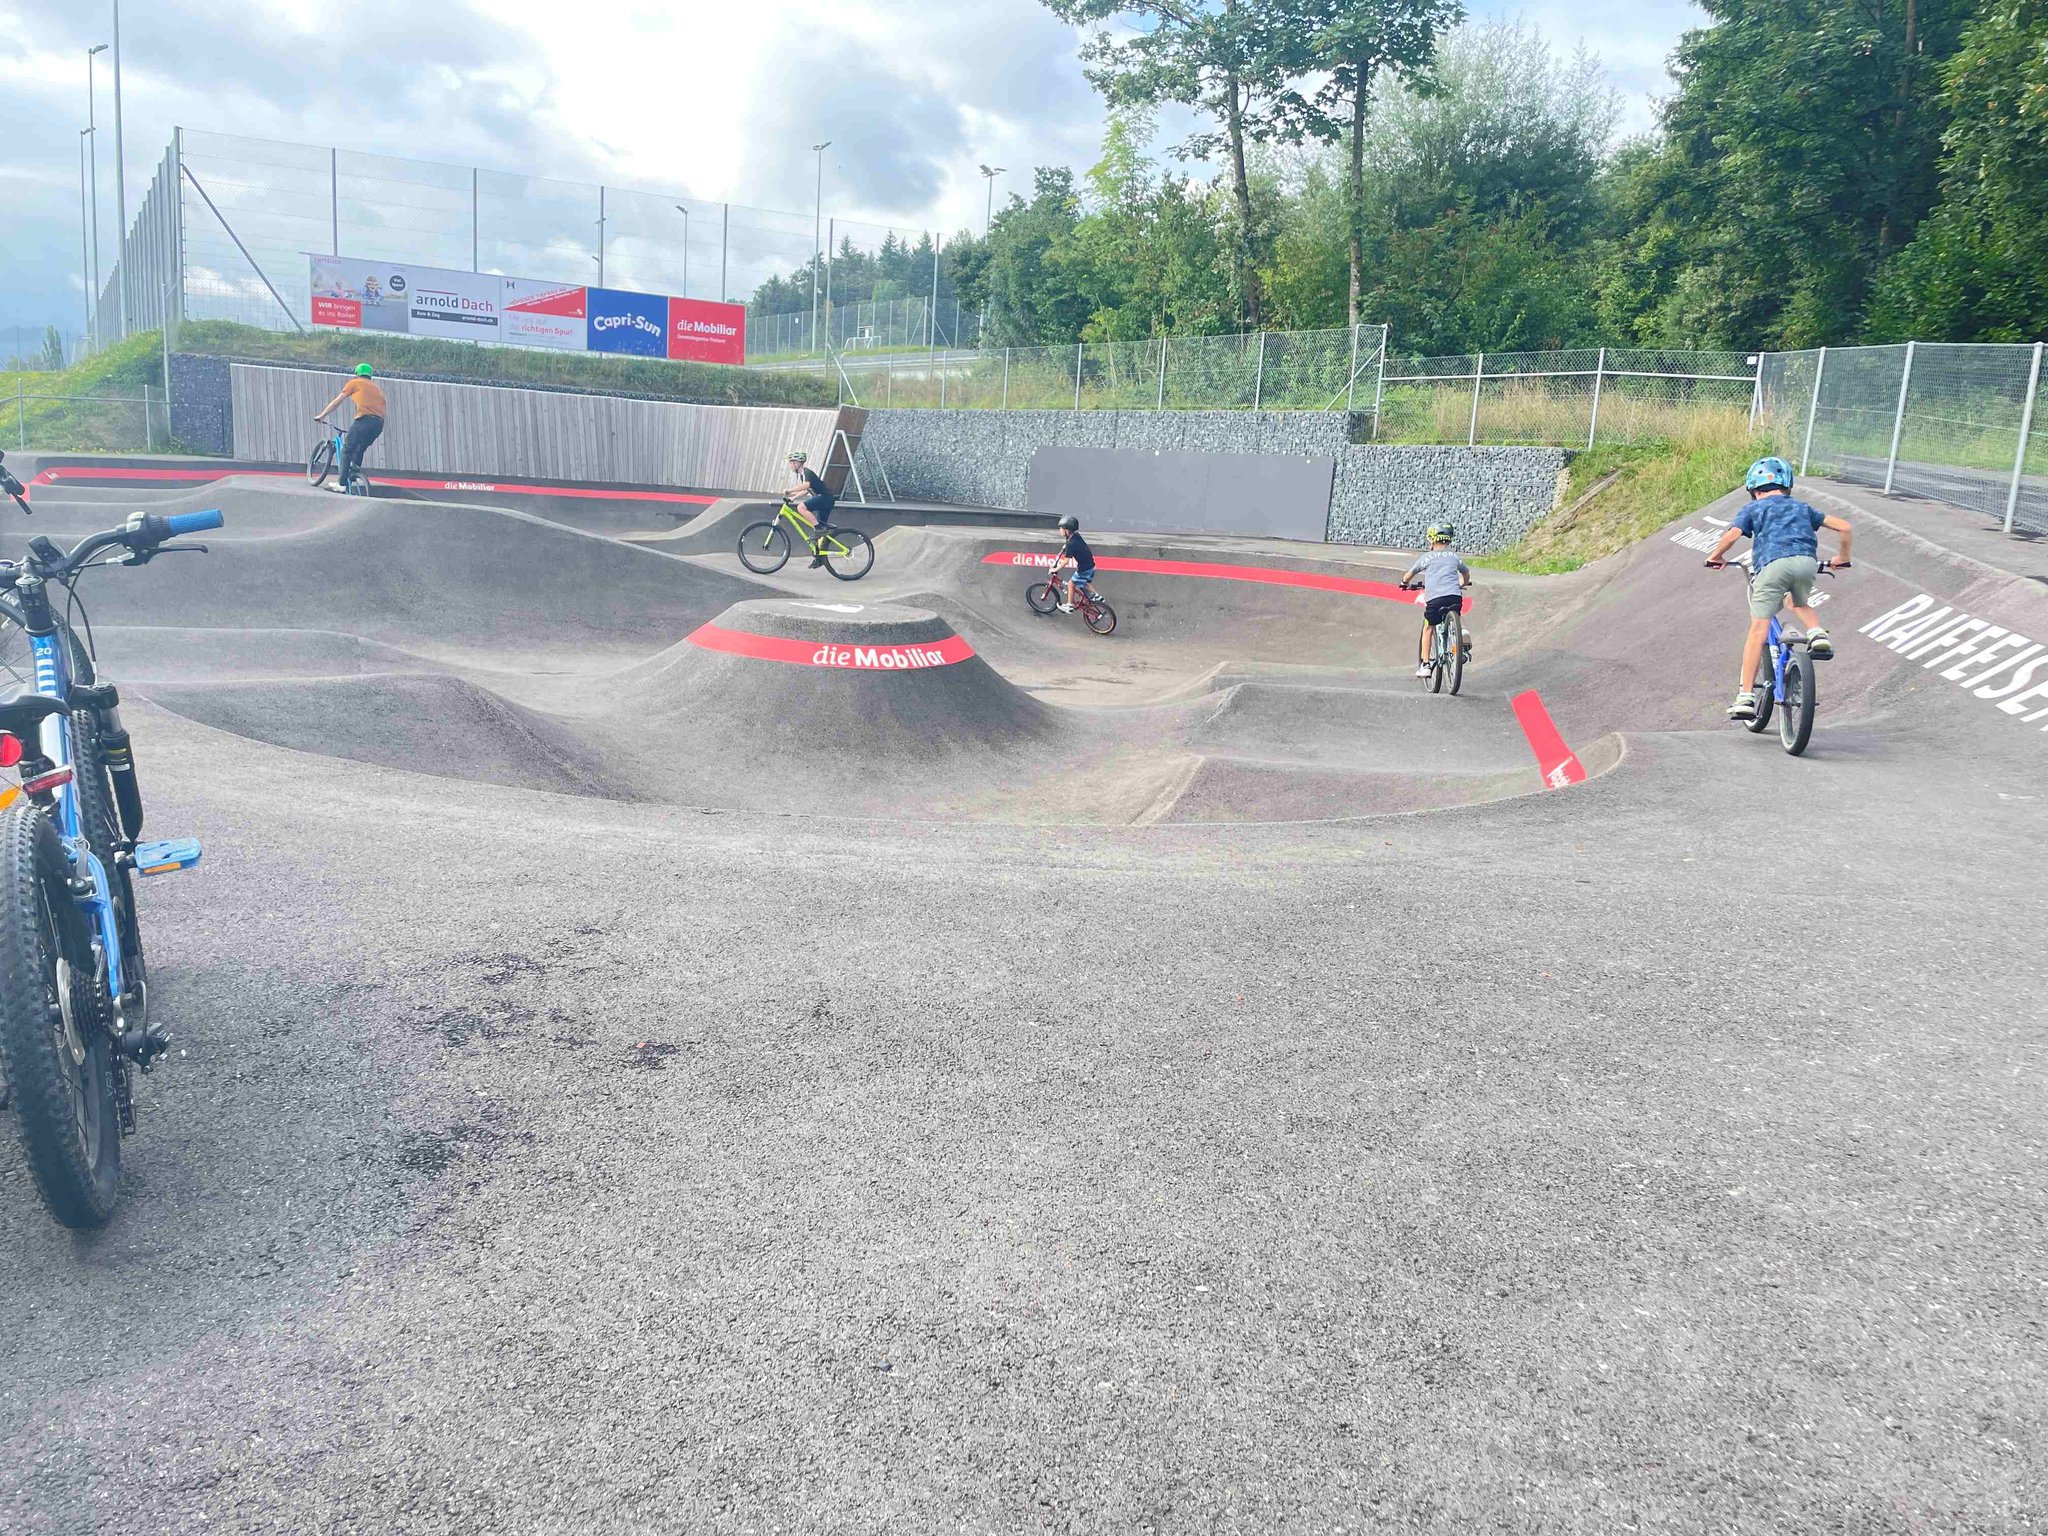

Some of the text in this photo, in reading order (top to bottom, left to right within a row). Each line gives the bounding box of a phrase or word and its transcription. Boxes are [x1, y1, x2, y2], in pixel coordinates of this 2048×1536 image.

[333, 302, 356, 312] bringen
[416, 295, 458, 308] arnold
[461, 298, 493, 312] Dach
[521, 324, 554, 334] richtigen
[593, 312, 662, 338] Capri-Sun
[677, 319, 737, 336] die Mobiliar
[444, 481, 495, 491] die Mobiliar
[1012, 553, 1033, 566] die
[36, 647, 52, 656] 20
[812, 645, 946, 668] die Mobiliar
